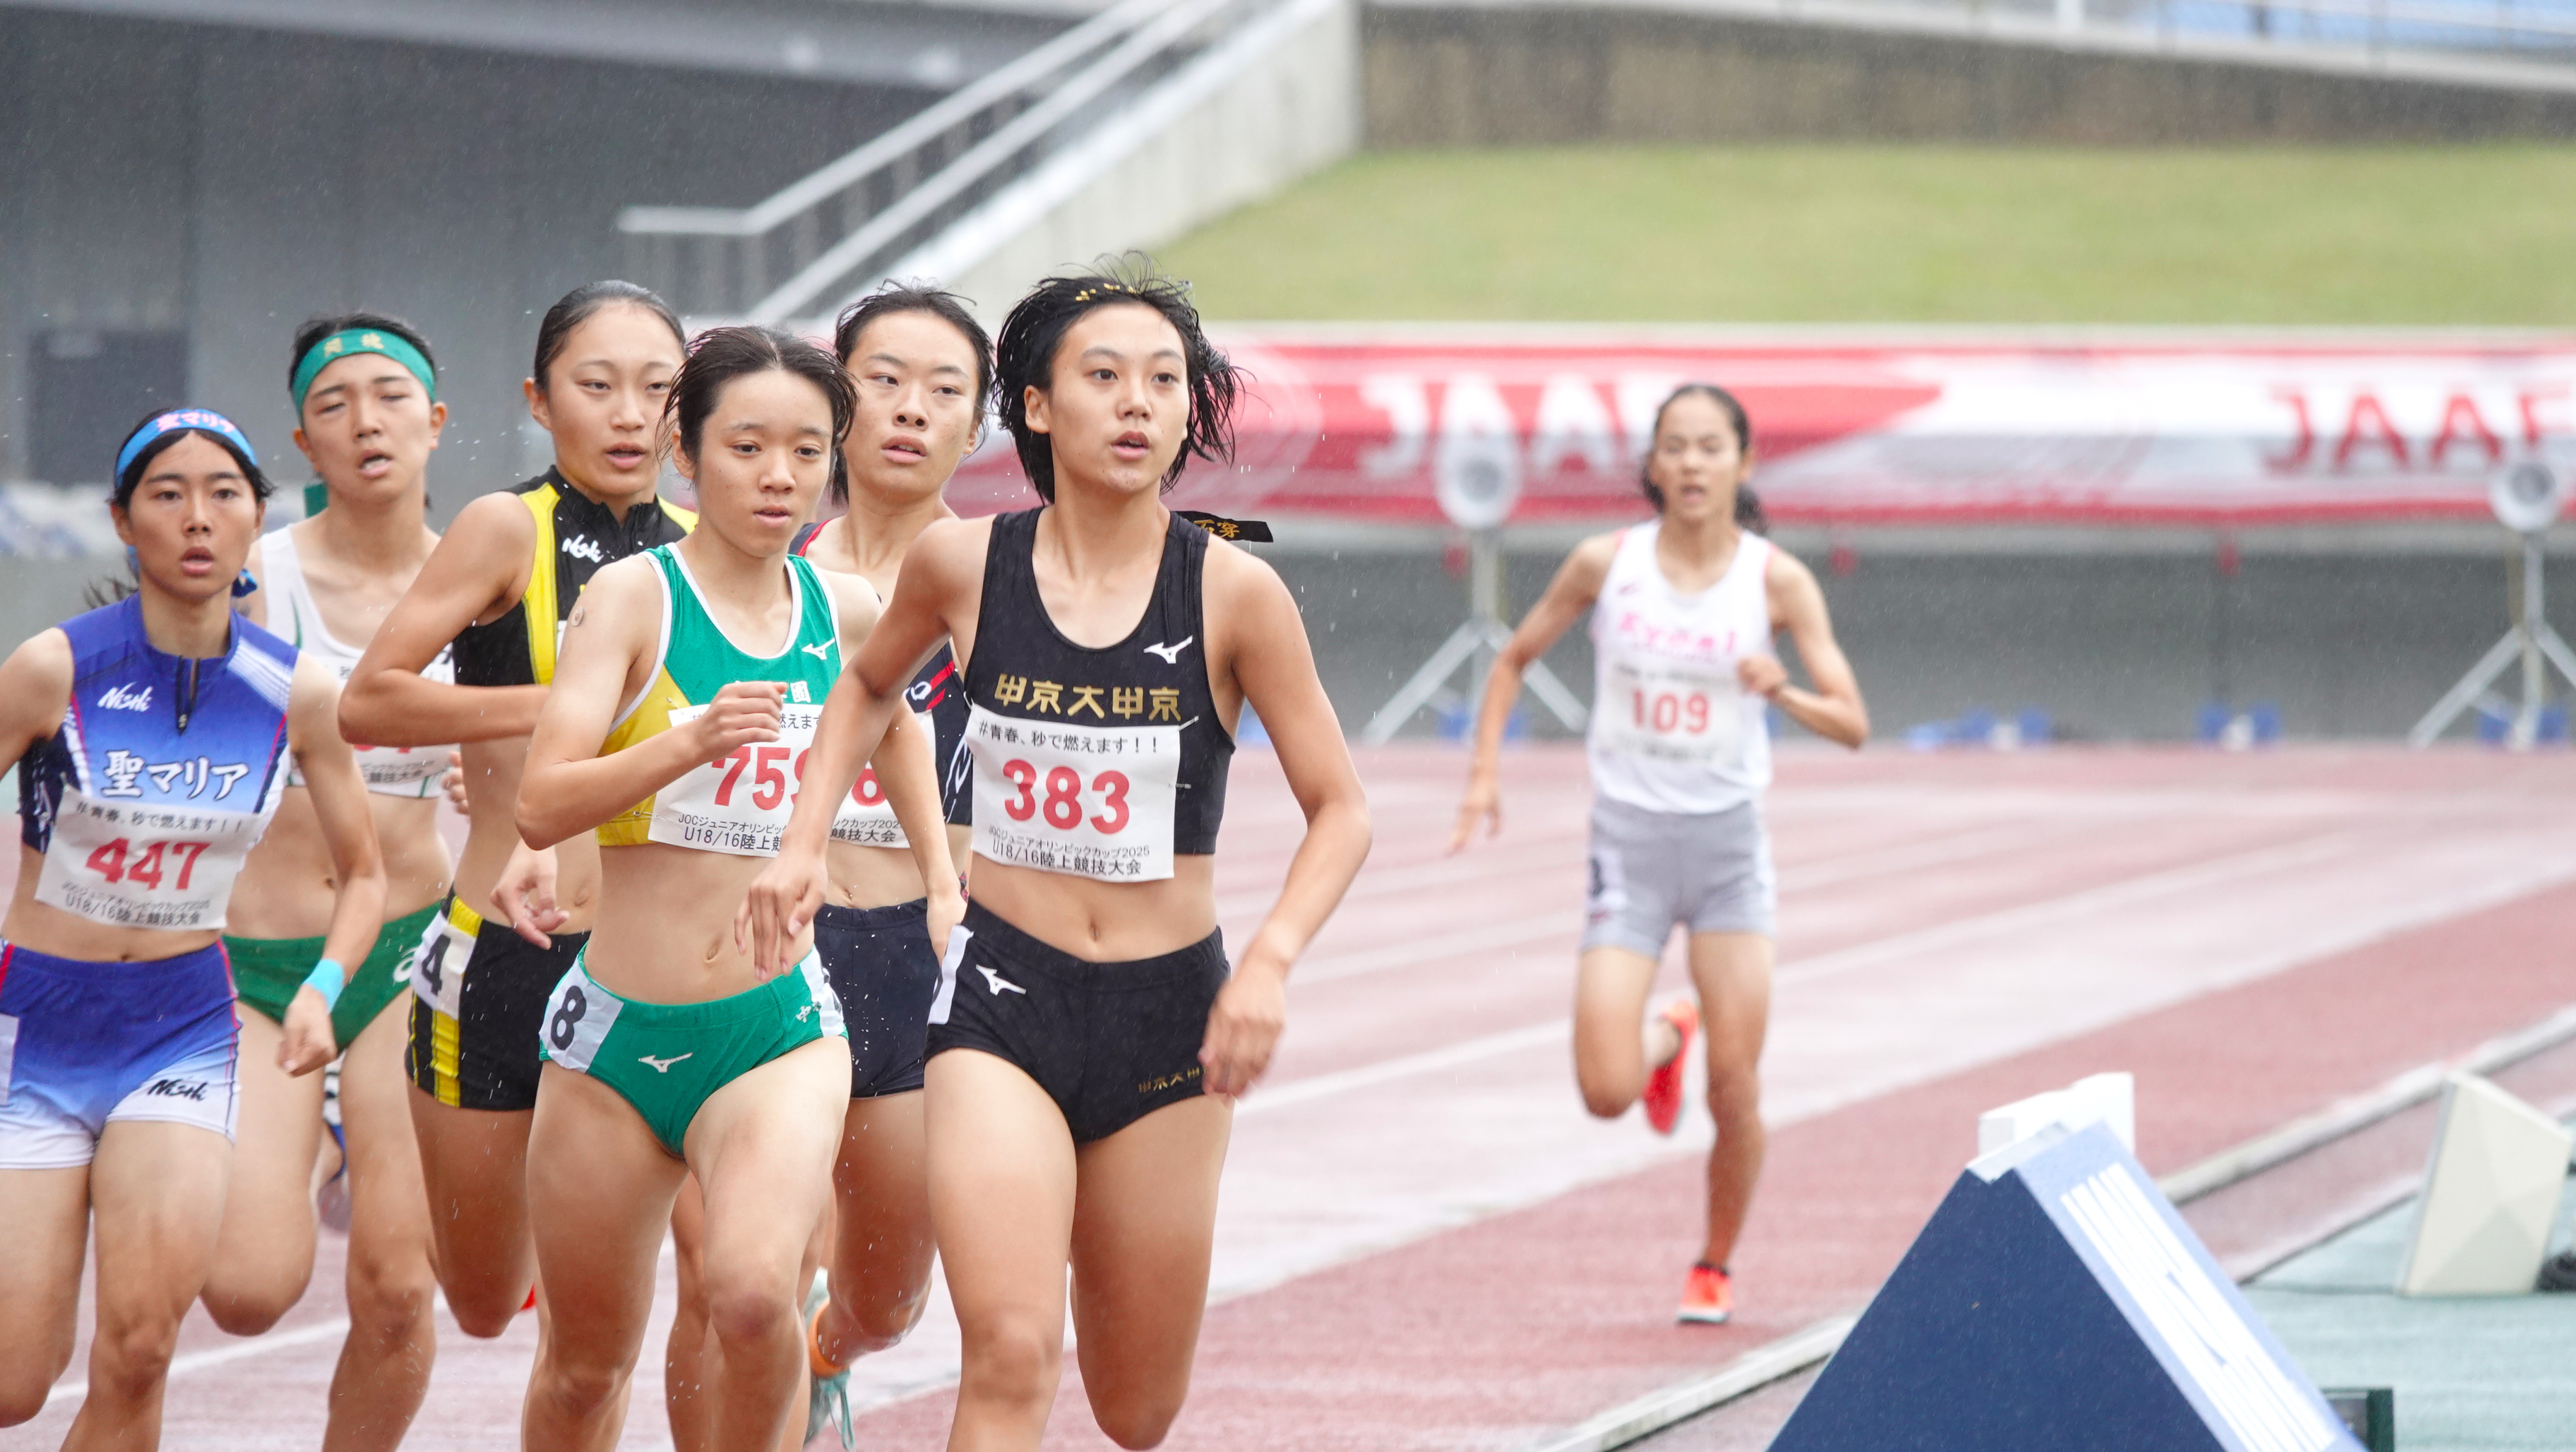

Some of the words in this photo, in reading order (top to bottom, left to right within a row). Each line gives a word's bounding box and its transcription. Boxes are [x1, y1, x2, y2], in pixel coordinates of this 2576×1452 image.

[1633, 686, 1710, 737] 109
[102, 749, 249, 801] 聖マリア
[1002, 758, 1130, 834] 383
[85, 837, 212, 891] 447
[992, 838, 1142, 876] U18/16陸上競技大会
[422, 933, 451, 997] 4
[551, 985, 587, 1051] 8
